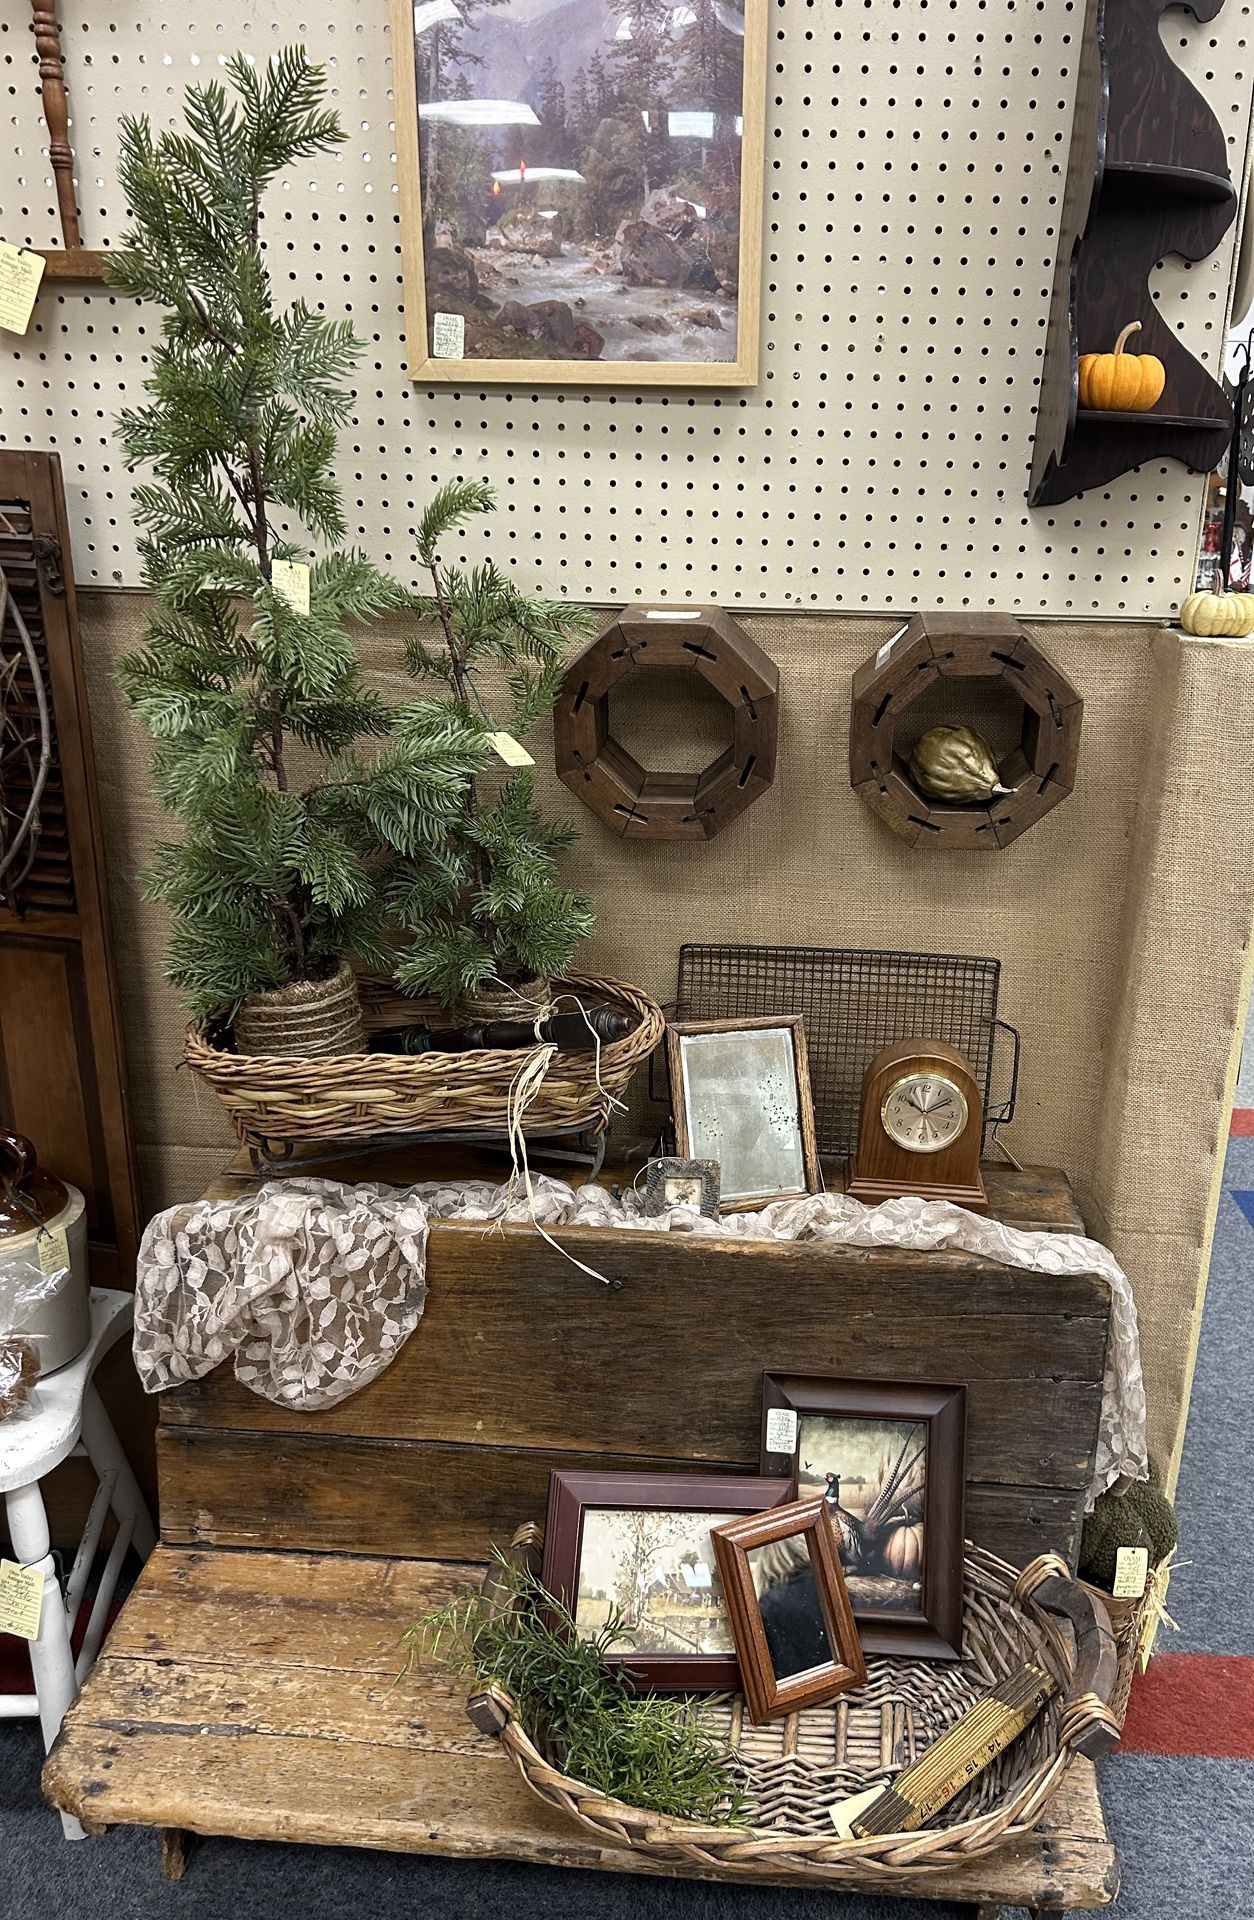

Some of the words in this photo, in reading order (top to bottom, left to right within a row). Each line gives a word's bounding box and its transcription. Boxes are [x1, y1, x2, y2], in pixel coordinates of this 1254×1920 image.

[908, 1086, 917, 1095] 11
[921, 1084, 932, 1093] 12
[897, 1094, 907, 1102] 10
[893, 1105, 900, 1114] 9
[947, 1111, 954, 1119] 3
[896, 1118, 903, 1127] 8
[942, 1121, 950, 1130] 4
[905, 1127, 912, 1136] 7
[931, 1130, 939, 1139] 5
[918, 1133, 925, 1141] 6
[987, 1738, 1001, 1753] 14
[965, 1759, 979, 1775] 15
[941, 1781, 957, 1798] 16
[919, 1802, 933, 1820] 17
